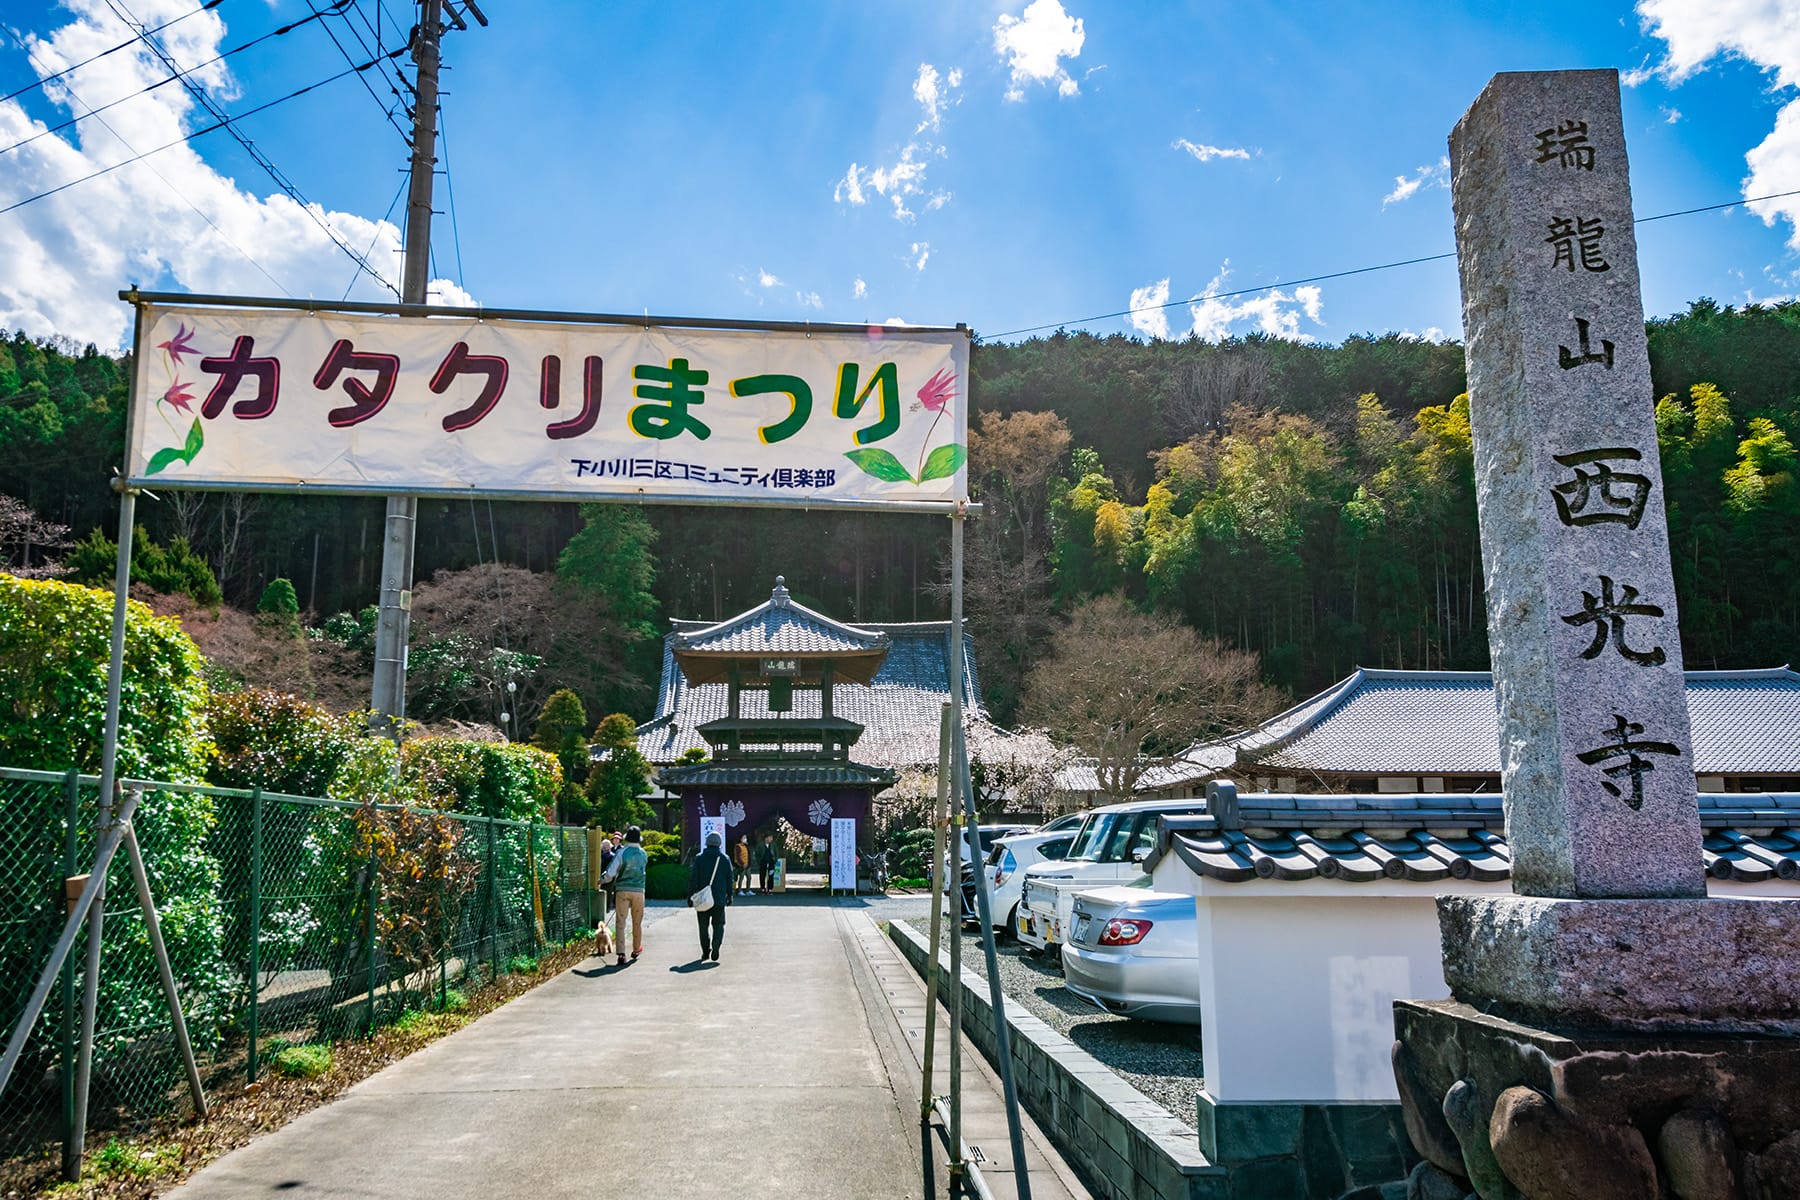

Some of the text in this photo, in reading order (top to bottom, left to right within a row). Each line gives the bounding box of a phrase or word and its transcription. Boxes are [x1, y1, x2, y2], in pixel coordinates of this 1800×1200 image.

[201, 335, 902, 445] カタクリまつり
[571, 458, 836, 489] 下小川三区コミュニティ倶楽部
